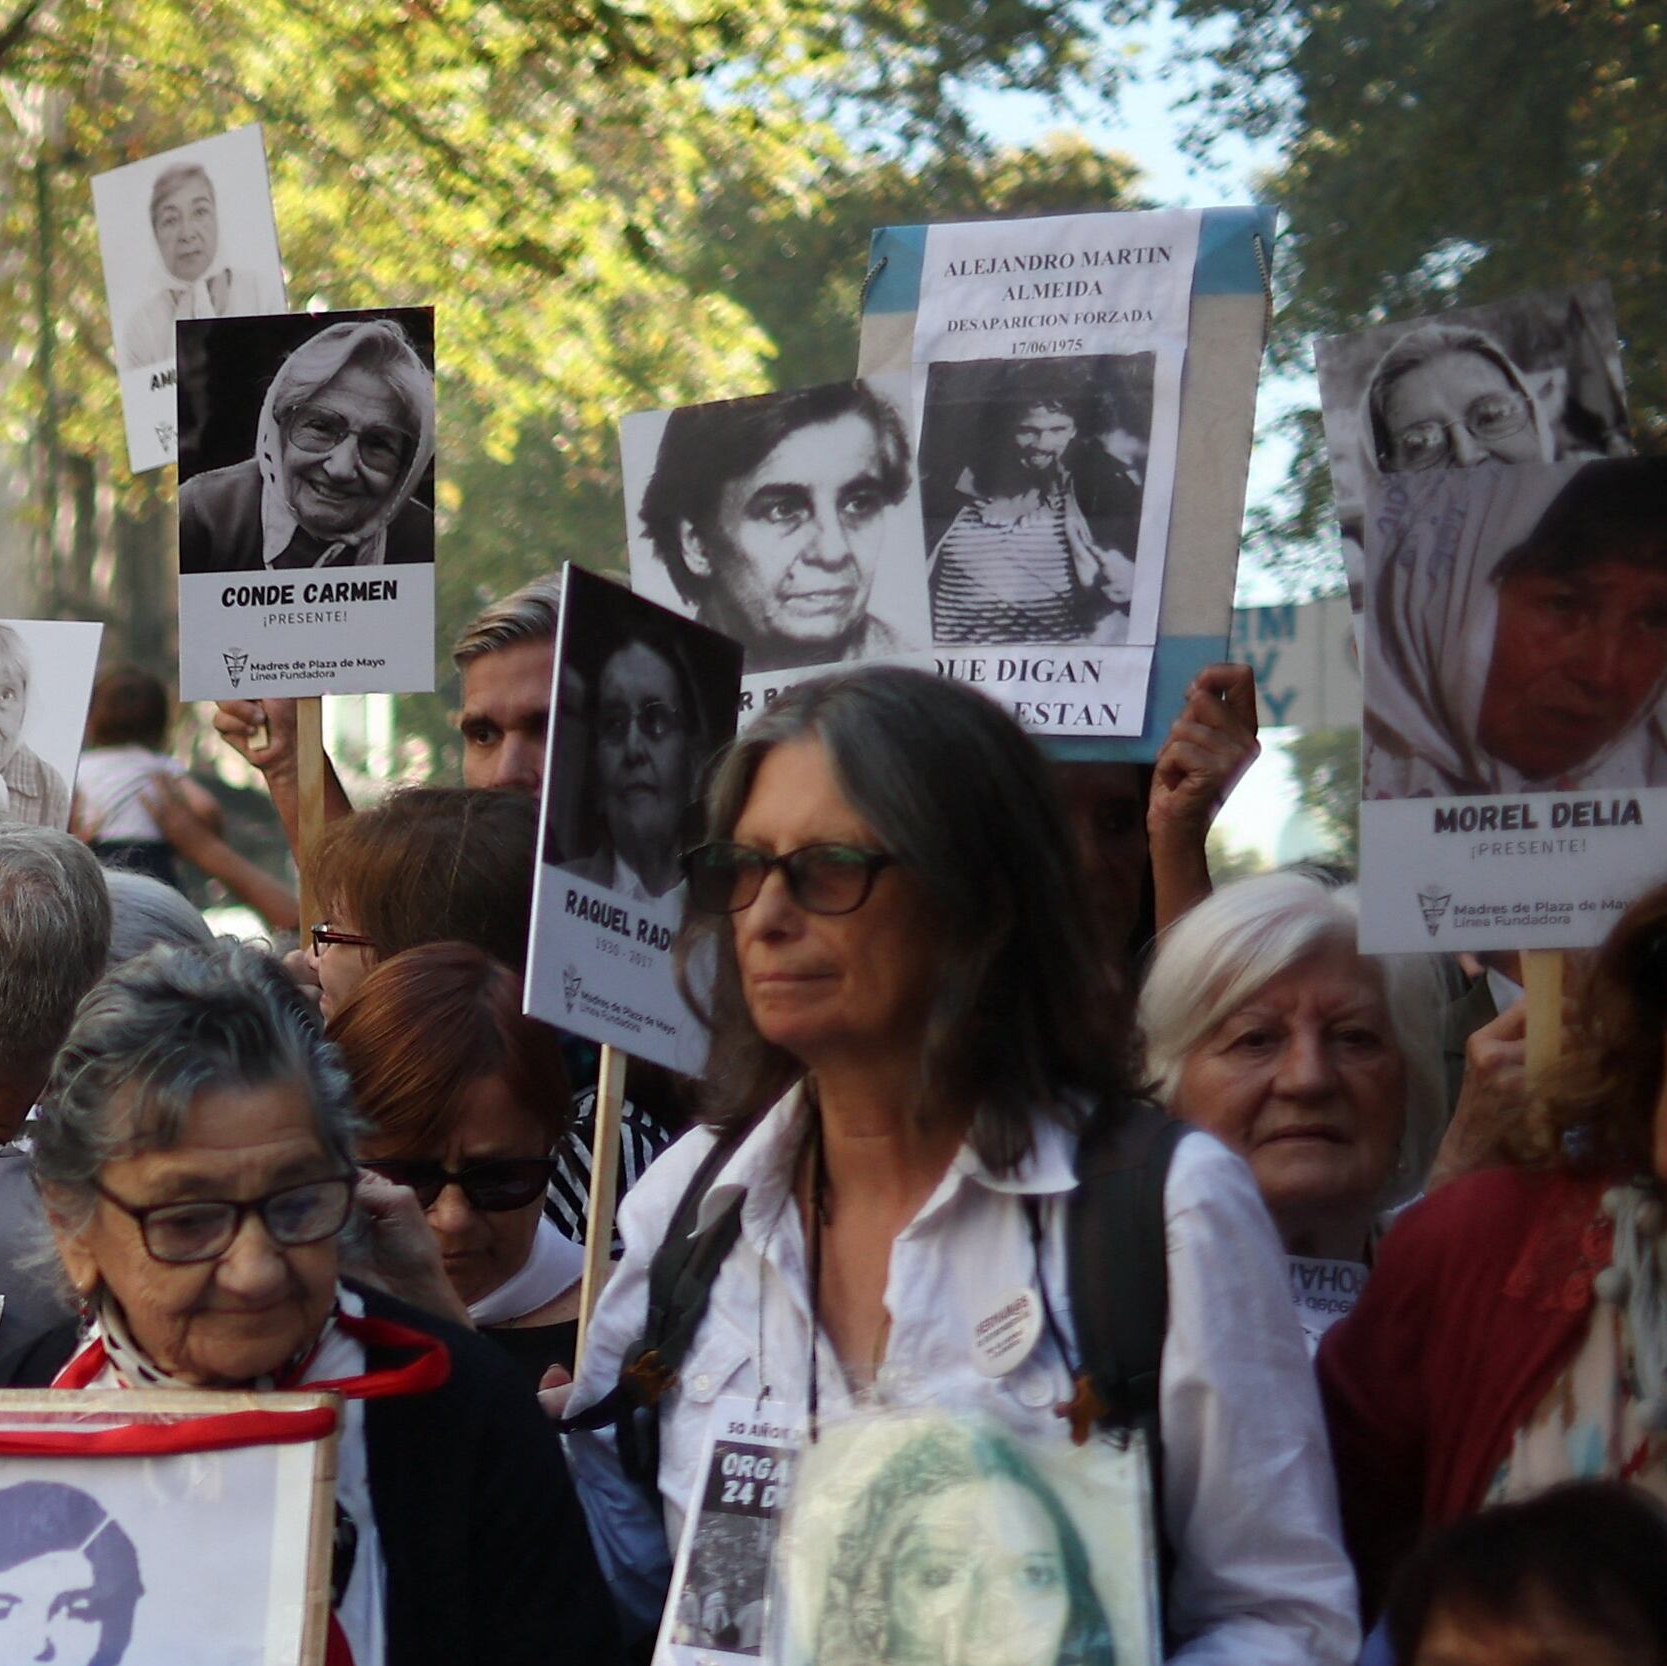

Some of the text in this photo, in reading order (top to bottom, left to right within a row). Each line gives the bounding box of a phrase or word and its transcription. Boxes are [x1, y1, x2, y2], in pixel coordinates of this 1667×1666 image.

[943, 245, 1173, 278] ALEJANDRO MARTIN
[1002, 279, 1104, 303] ALMEIDA
[946, 307, 1154, 333] DESAPARICION FORZADA
[1010, 336, 1084, 357] 17/06/1975
[221, 579, 398, 608] CONDE CARMEN
[250, 656, 386, 672] Madres de Plaza de Mayo
[279, 668, 336, 680] Fundadora
[996, 656, 1103, 685] DIGAN
[1014, 702, 1121, 728] ESTAN
[1434, 799, 1643, 833] MOREL DELIA
[1600, 896, 1631, 912] May
[565, 889, 674, 955] RAQUEL RAD
[721, 1452, 791, 1484] ORGA
[721, 1479, 756, 1505] 24
